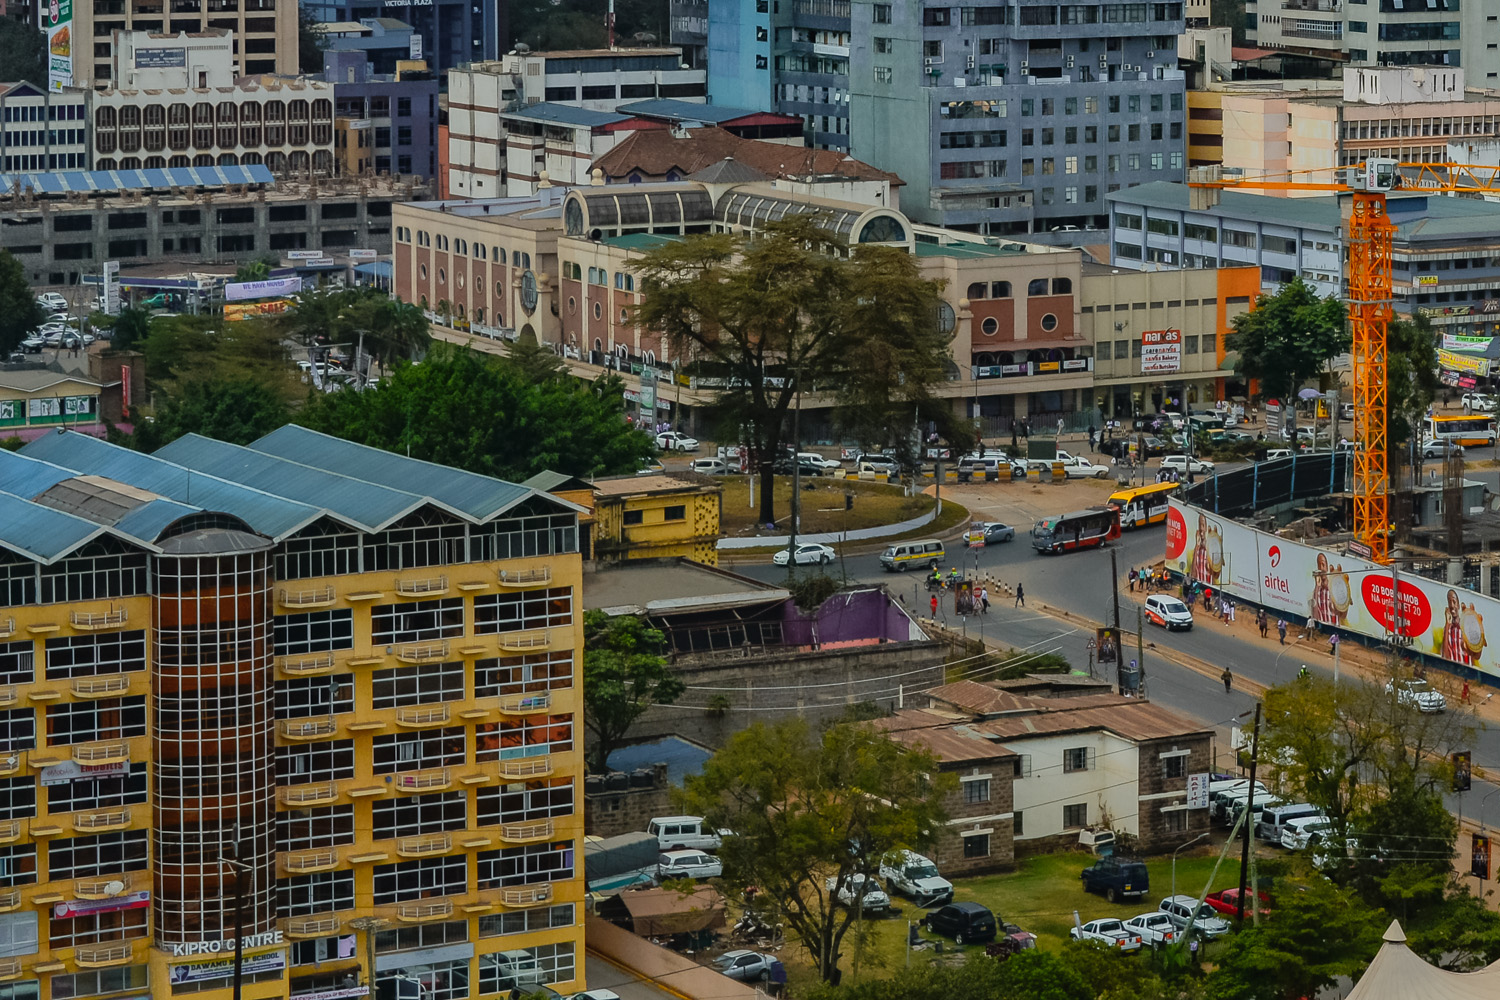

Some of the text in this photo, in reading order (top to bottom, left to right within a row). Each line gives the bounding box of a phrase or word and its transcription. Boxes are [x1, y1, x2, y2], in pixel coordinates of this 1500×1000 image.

[384, 0, 412, 7] VICTORIA
[252, 282, 266, 290] HAVE
[266, 280, 285, 288] MOVED
[260, 302, 285, 314] SALE
[1145, 329, 1178, 342] naivas
[1265, 572, 1290, 594] airtel
[1371, 584, 1380, 593] 20
[1380, 586, 1394, 598] BOB
[1403, 593, 1419, 605] MOB
[1371, 593, 1381, 603] NA
[1412, 606, 1421, 616] 20
[1191, 776, 1199, 806] RAFIKI
[173, 940, 221, 956] KIPRO
[190, 952, 280, 970] DAWAMU BS' SCHOOL
